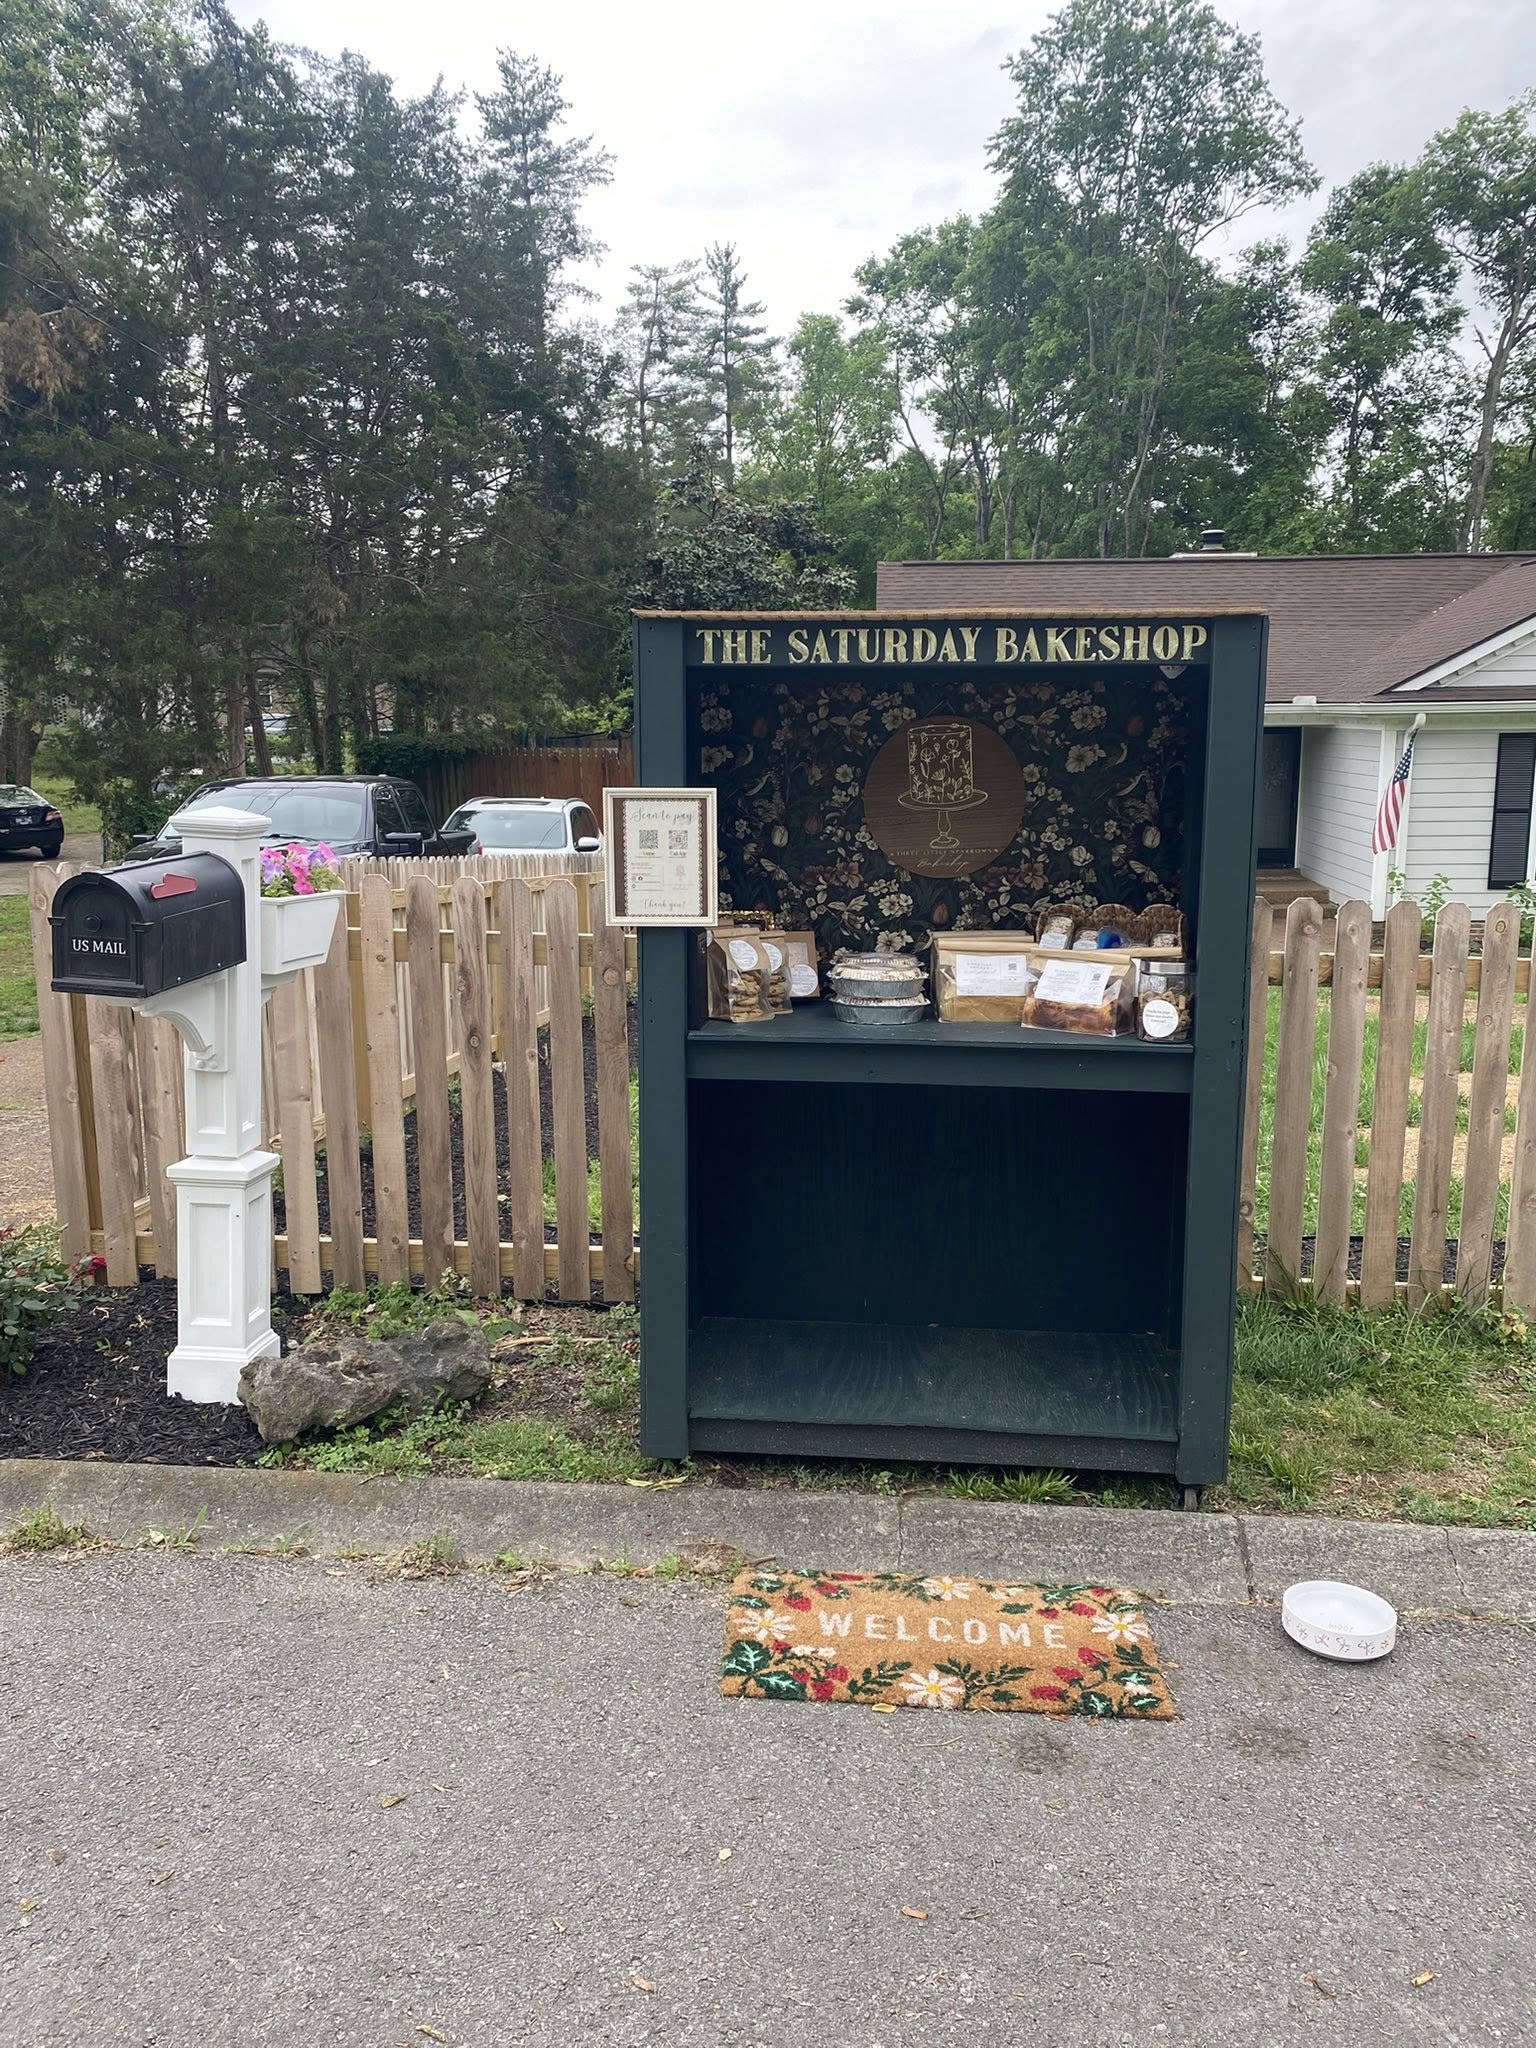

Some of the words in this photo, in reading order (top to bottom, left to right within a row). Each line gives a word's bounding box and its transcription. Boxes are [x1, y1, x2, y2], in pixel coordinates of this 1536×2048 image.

[696, 629, 772, 665] THE
[788, 627, 983, 665] SATURDAY
[994, 624, 1208, 663] BAKESHOP
[631, 806, 658, 822] Scan
[662, 809, 670, 820] to
[673, 812, 693, 826] pay
[643, 899, 667, 909] Thank
[72, 939, 89, 952] US
[92, 941, 126, 954] MAIL
[818, 1610, 1068, 1650] WELCOME
